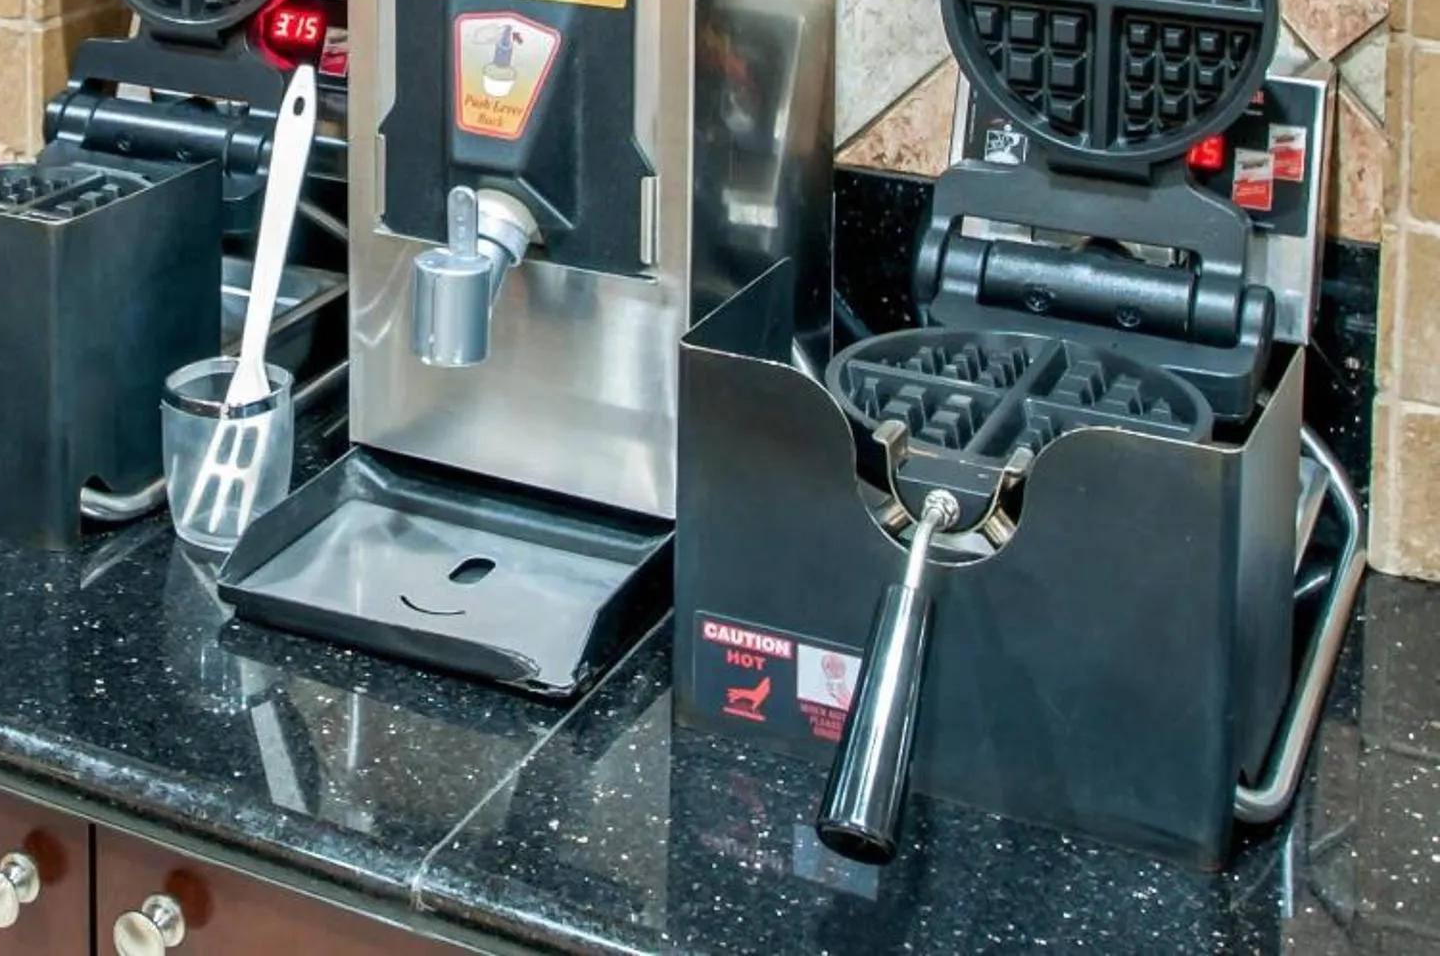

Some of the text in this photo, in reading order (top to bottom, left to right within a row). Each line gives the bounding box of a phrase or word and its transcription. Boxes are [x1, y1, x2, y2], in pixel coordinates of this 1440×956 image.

[272, 11, 319, 41] 315
[464, 94, 491, 110] Push
[702, 621, 792, 660] CAUTION
[726, 649, 767, 671] HOT
